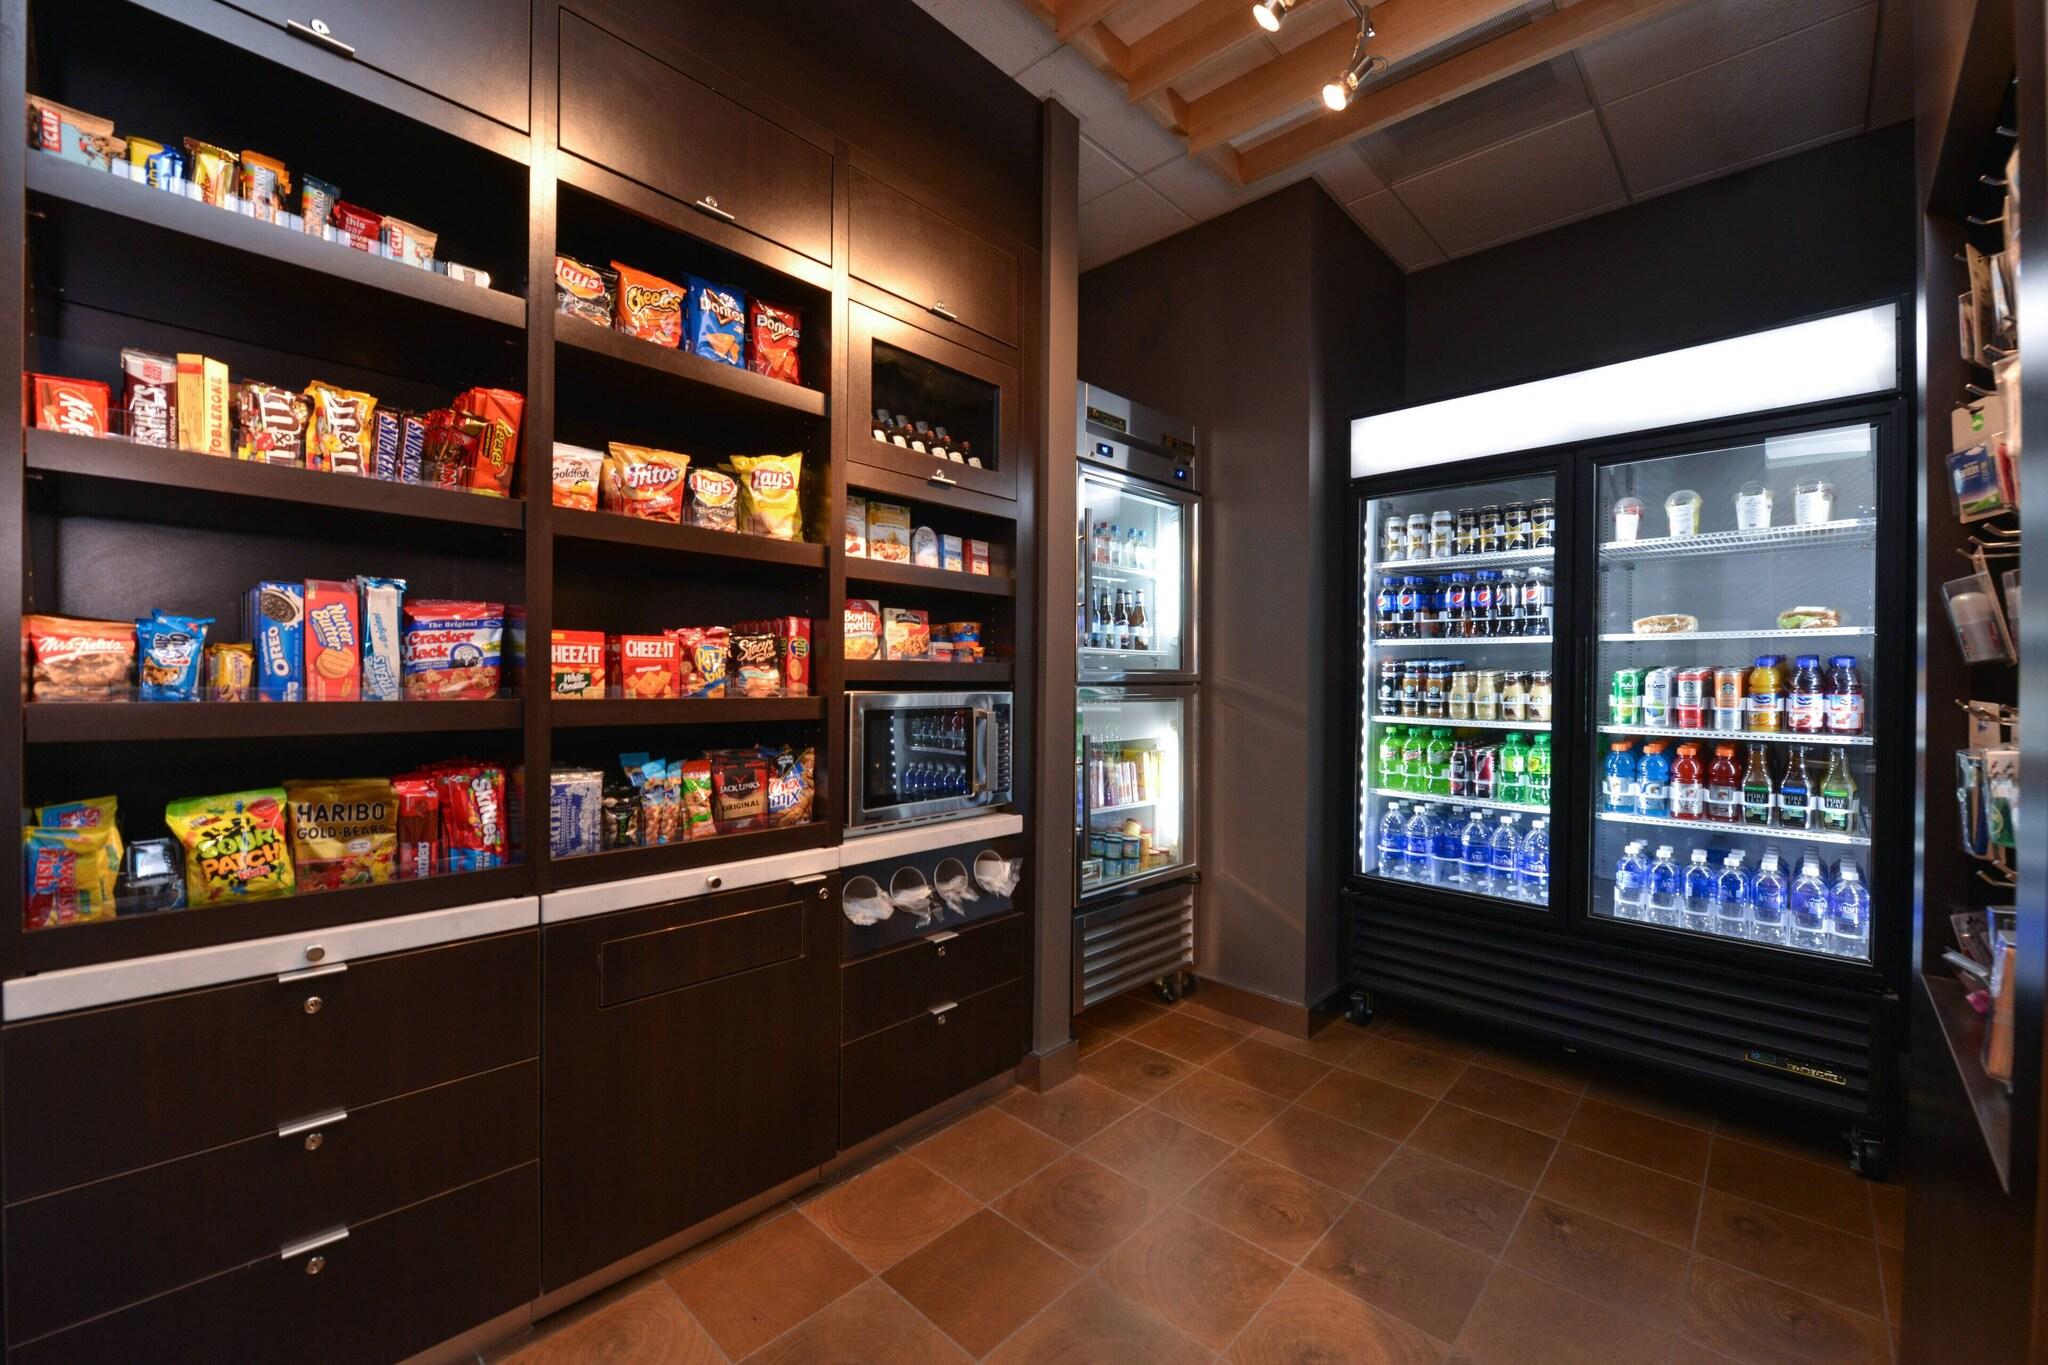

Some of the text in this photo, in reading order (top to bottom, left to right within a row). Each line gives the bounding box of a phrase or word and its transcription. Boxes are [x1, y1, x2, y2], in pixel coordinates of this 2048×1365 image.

[627, 285, 681, 315] Cheetos
[700, 297, 745, 325] Doritos
[757, 314, 800, 339] Doritos
[209, 376, 223, 455] TOBLERONE
[377, 414, 398, 482] SNICKERS
[401, 417, 424, 484] SNICKERS
[553, 467, 590, 481] Goldfish
[627, 463, 679, 487] Fritos
[311, 609, 342, 650] Butter
[326, 603, 354, 647] Nutter
[444, 619, 478, 630] Original
[268, 626, 289, 677] OREO
[409, 631, 475, 646] Cracker
[625, 639, 676, 659] CHEEZ-IT
[738, 638, 775, 661] Stacy's
[408, 643, 449, 661] Jack
[552, 644, 602, 665] HEEZ-IT
[720, 783, 738, 793] JACK
[770, 789, 800, 809] mix
[297, 802, 386, 823] HARIBO
[471, 777, 499, 847] Skittles
[721, 800, 761, 812] ORIGINAL
[198, 829, 275, 859] SOUR
[36, 847, 54, 887] Fish
[200, 843, 282, 880] PATCH
[56, 849, 76, 921] Swedish
